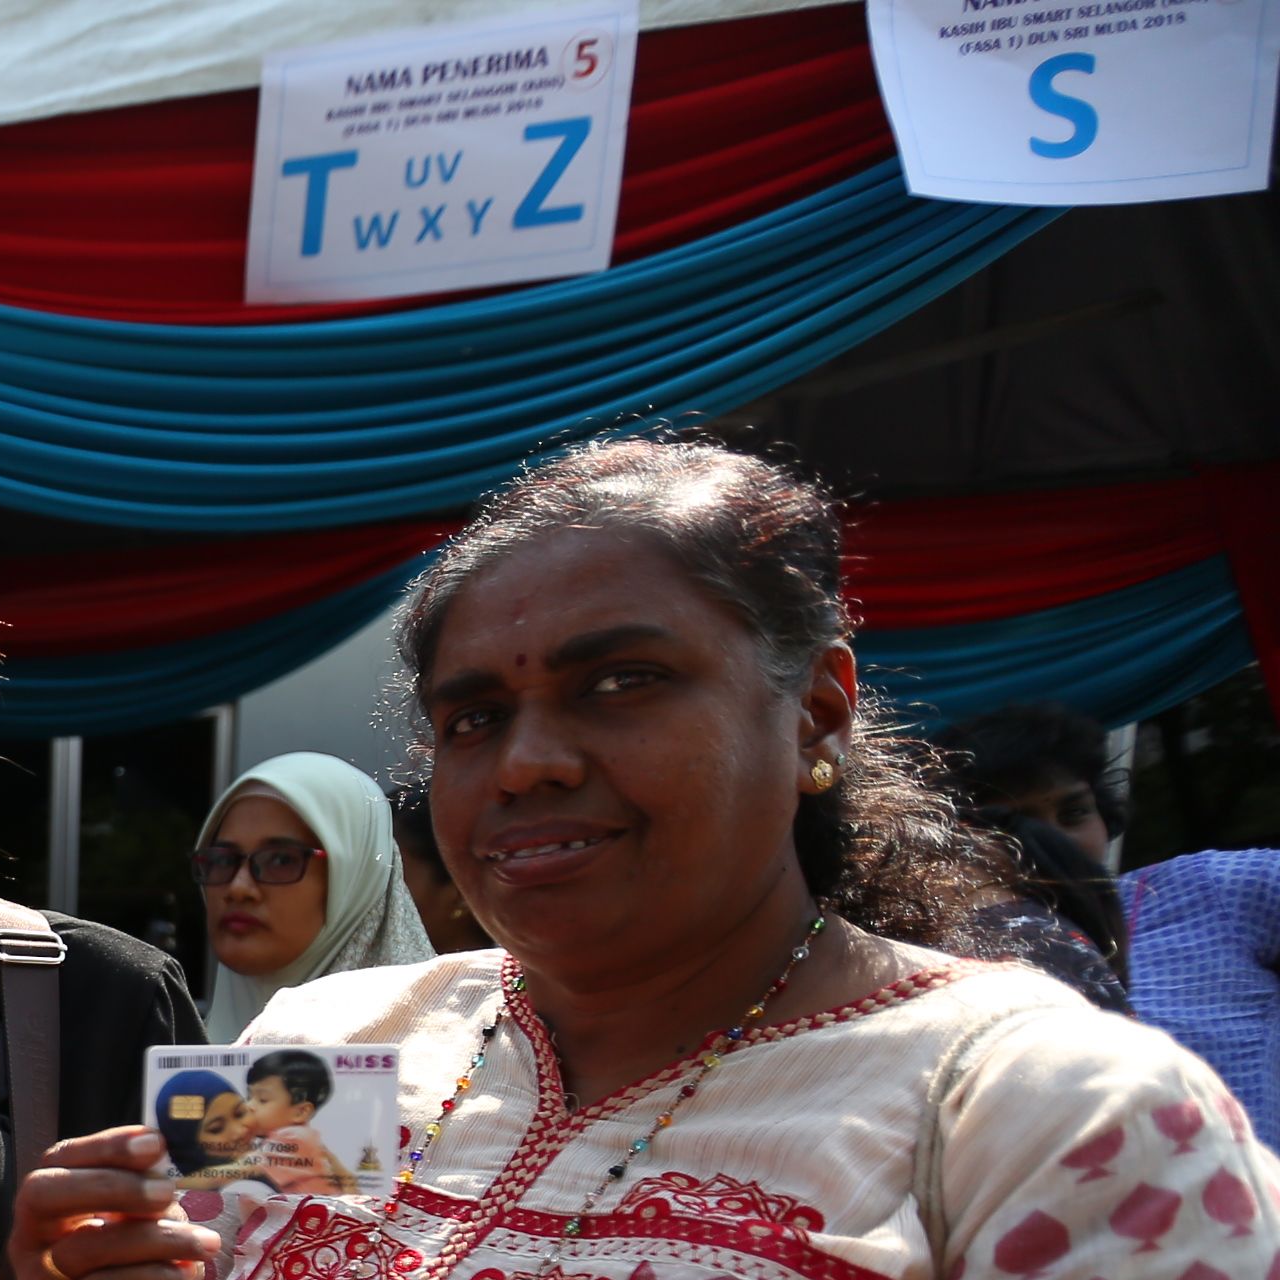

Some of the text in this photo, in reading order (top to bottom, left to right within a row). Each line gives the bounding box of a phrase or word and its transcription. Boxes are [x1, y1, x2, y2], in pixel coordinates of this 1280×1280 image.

[939, 0, 1156, 39] KASIH IBU SMART SELANGOR
[959, 11, 1186, 56] (FASA 1) DUN SRI MUDA 2018
[346, 47, 549, 95] NAMA PENERIMA
[574, 39, 598, 78] 5
[1029, 52, 1099, 159] S
[404, 150, 463, 189] UV
[511, 116, 593, 230] Z
[282, 149, 358, 257] T
[353, 197, 494, 251] W X Y
[335, 1054, 397, 1069] KISS
[267, 1156, 315, 1168] TITTAN
